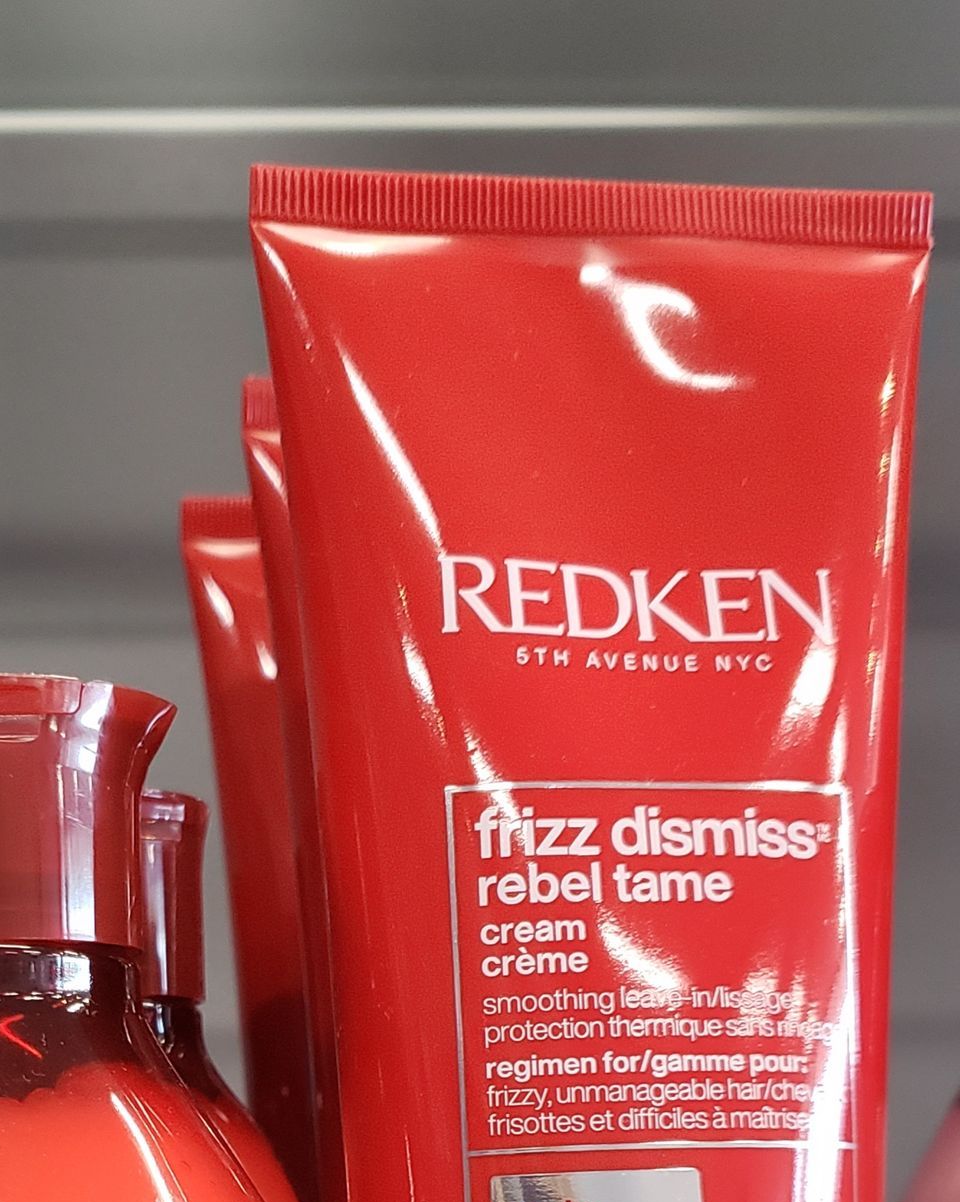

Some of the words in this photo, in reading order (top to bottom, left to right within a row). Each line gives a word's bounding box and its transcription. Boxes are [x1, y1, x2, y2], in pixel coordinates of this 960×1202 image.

[439, 555, 837, 645] REDKEN
[516, 646, 570, 667] 5TH
[586, 651, 700, 672] AVENUE
[715, 653, 774, 673] NYC
[474, 806, 601, 859] frizz
[611, 805, 818, 860] dismiss
[478, 861, 603, 907] rebel
[612, 864, 734, 903] tame
[480, 918, 586, 945] cream
[481, 947, 589, 977] crème
[483, 986, 615, 1015] smoothing
[620, 985, 796, 1014] leave-in/lissage
[484, 1017, 604, 1048] protection
[608, 1014, 724, 1041] thermique
[725, 1018, 774, 1037] sans
[485, 1054, 597, 1083] regimen
[602, 1049, 746, 1078] for/gamme
[749, 1053, 809, 1077] pour:
[486, 1085, 552, 1110] frizzy,
[556, 1078, 724, 1106] unmanageable
[589, 1109, 615, 1131] et
[618, 1106, 708, 1131] difficiles
[711, 1105, 729, 1129] à
